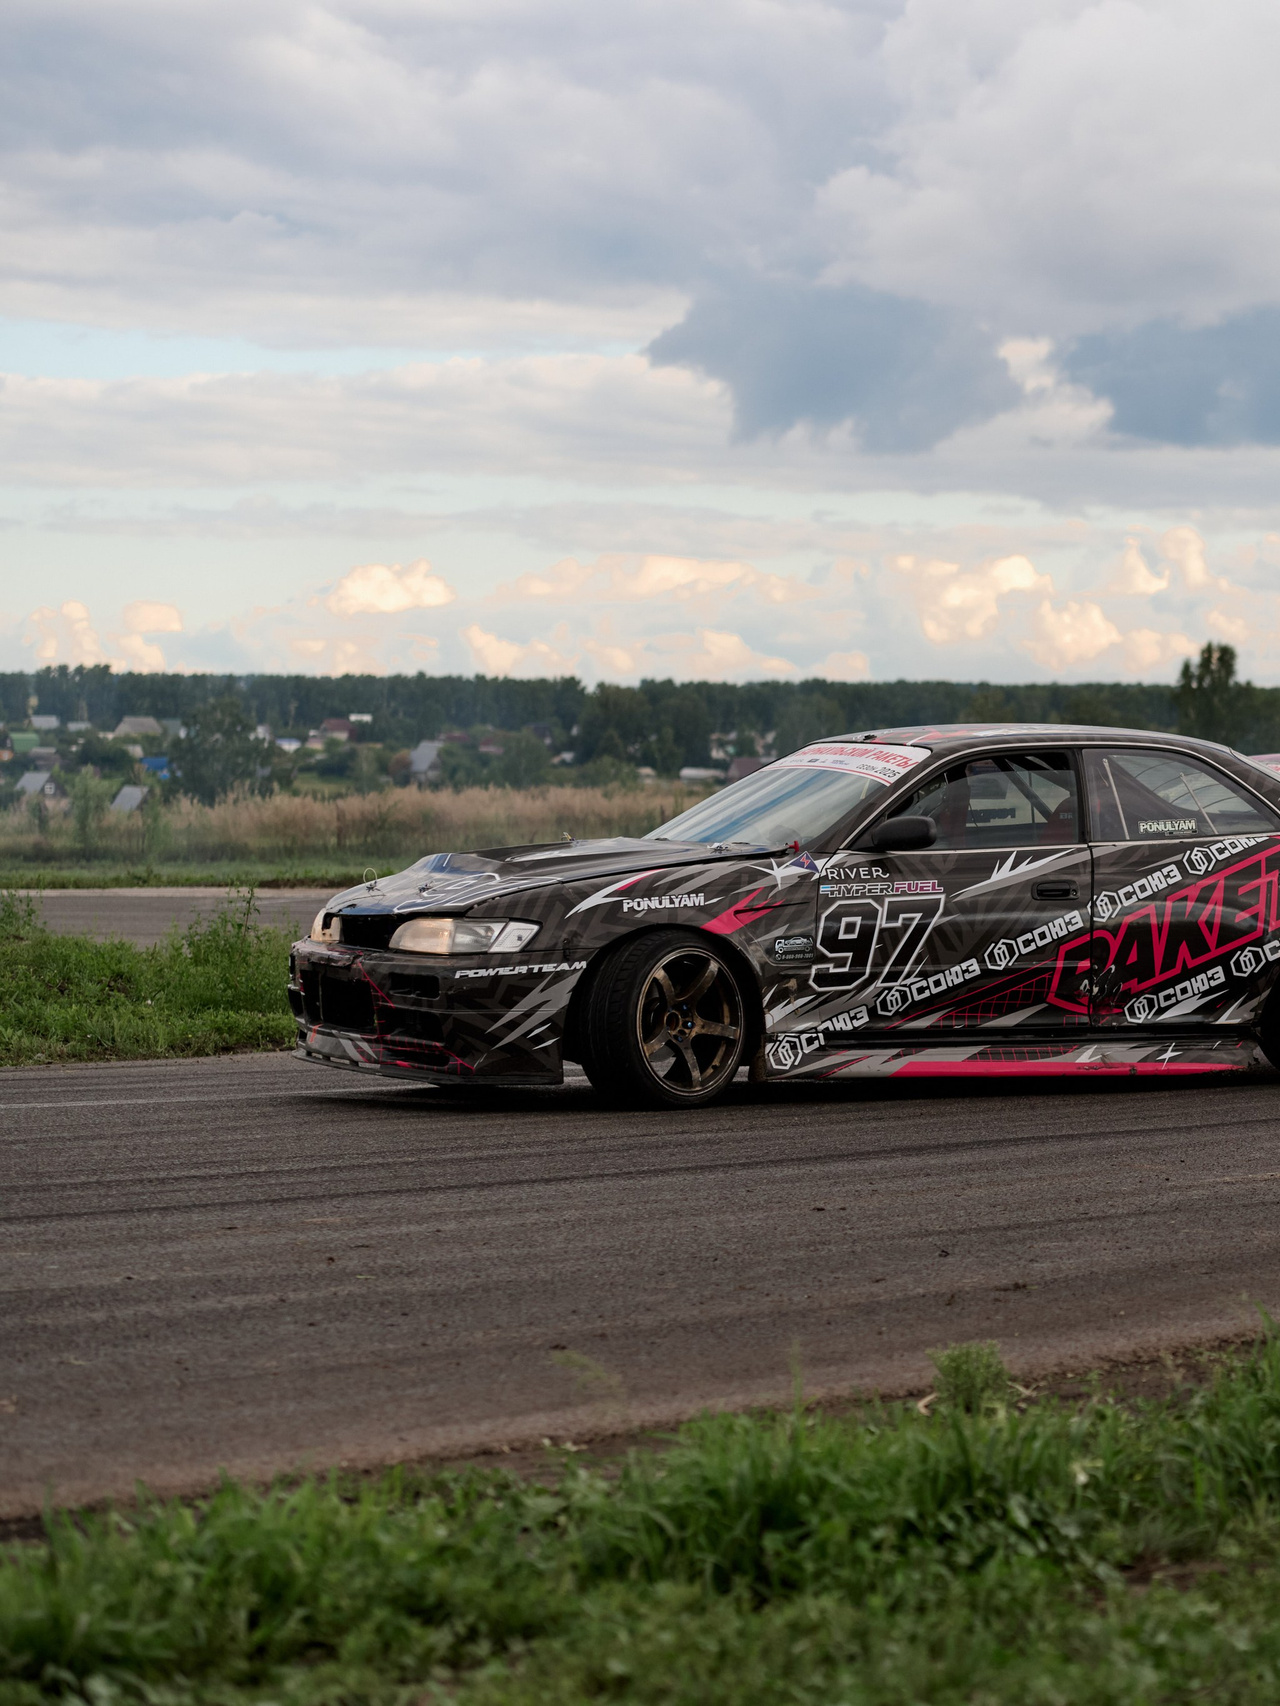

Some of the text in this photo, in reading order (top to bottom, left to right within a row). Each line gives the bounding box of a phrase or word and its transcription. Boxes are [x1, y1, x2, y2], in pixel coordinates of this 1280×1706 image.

[865, 750, 919, 769] РАКЕТЫ
[874, 767, 901, 778] 2025
[1139, 819, 1197, 833] PONULYAM
[826, 867, 890, 880] RIVER
[1117, 863, 1183, 907] СОЮЗ
[622, 893, 705, 913] PONULYAM
[809, 894, 946, 991] 97
[1016, 909, 1084, 955] СОЮЗ
[911, 957, 981, 1002] СОЮЗ
[1157, 965, 1226, 1008] СОЮЗ
